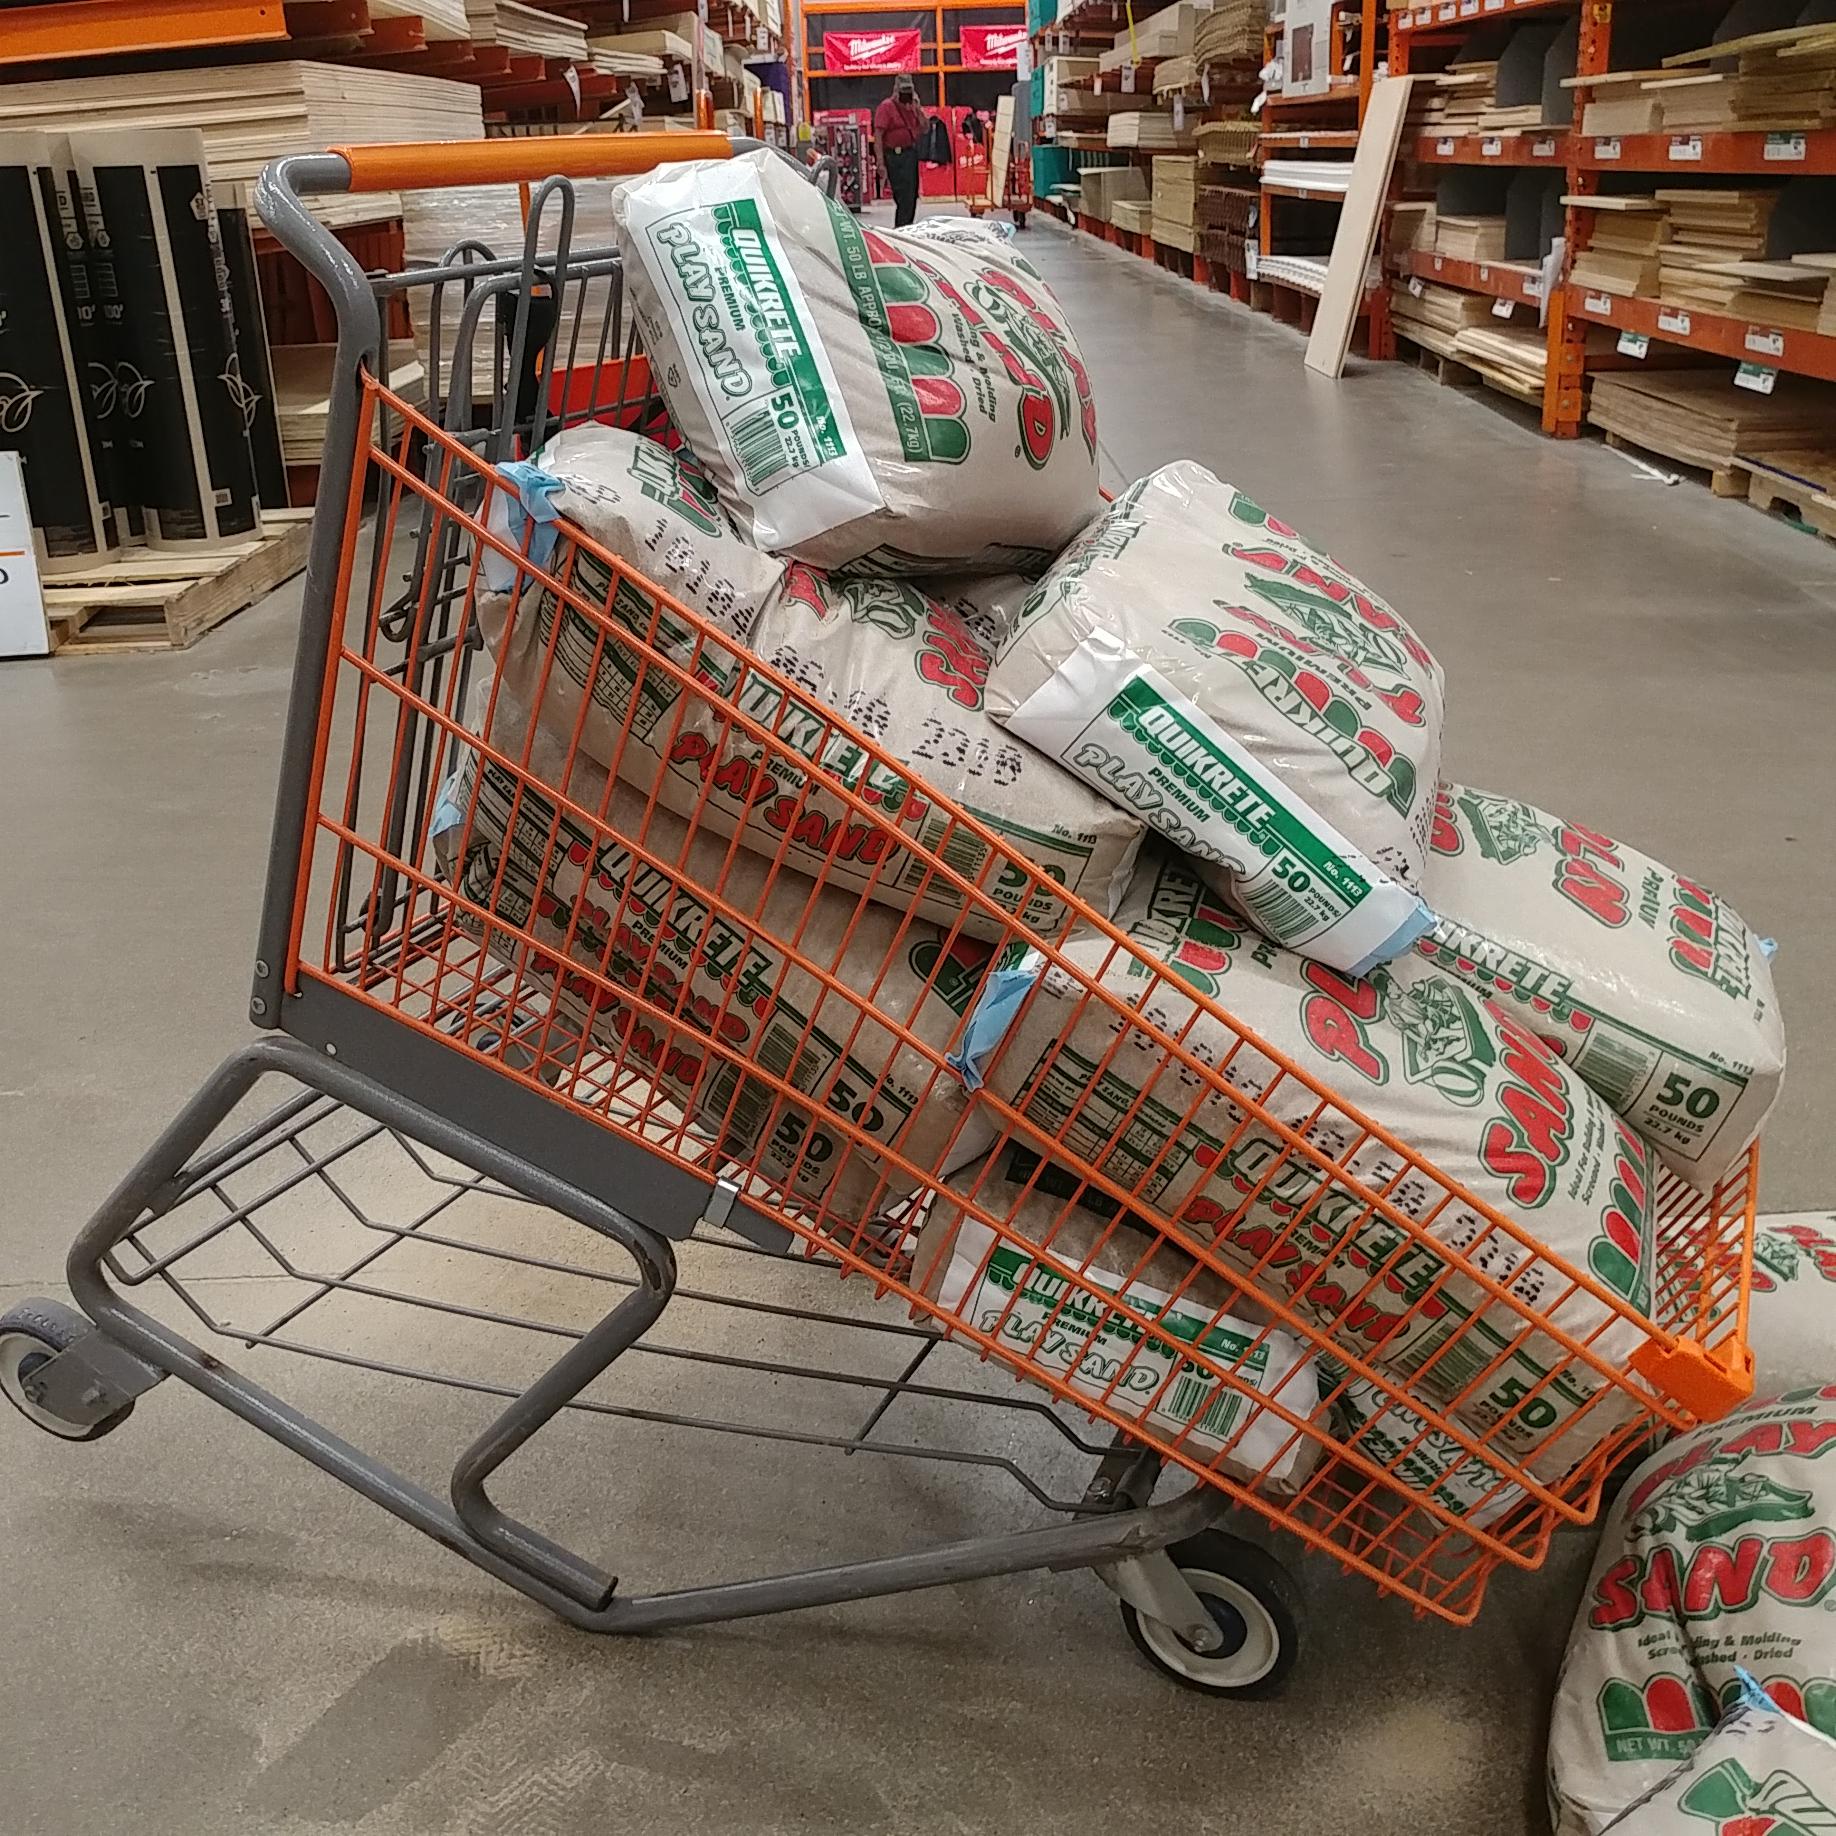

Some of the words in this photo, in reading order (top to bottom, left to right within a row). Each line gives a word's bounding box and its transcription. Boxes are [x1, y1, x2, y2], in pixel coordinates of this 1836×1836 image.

[713, 266, 746, 331] PREMIUM
[729, 227, 802, 358] QUIKRETE
[852, 264, 867, 286] LB
[656, 222, 717, 303] PLAY
[692, 303, 753, 397] SAND
[771, 391, 800, 430] 50
[1255, 632, 1373, 712] PREMIUM
[1073, 742, 1164, 811] PLAY
[1138, 704, 1277, 834] QUIKRETE
[1147, 766, 1212, 823] PREMIUM
[762, 795, 900, 866] SAND
[1271, 857, 1312, 893] 50
[1323, 859, 1341, 880] No.
[632, 919, 689, 971] PREMIUM
[1708, 1050, 1728, 1065] No.
[826, 1078, 885, 1133] 50
[1649, 1104, 1705, 1133] POUNDS
[1656, 1071, 1720, 1119] 50
[775, 1111, 834, 1163] 50
[1643, 1117, 1673, 1134] 22.7
[1059, 1341, 1161, 1392] SAND
[1219, 1337, 1240, 1353] No.
[1487, 1376, 1558, 1430] 50
[1588, 1527, 1836, 1632] SAND
[1752, 1648, 1794, 1661] Dried
[1616, 1737, 1645, 1754] NET
